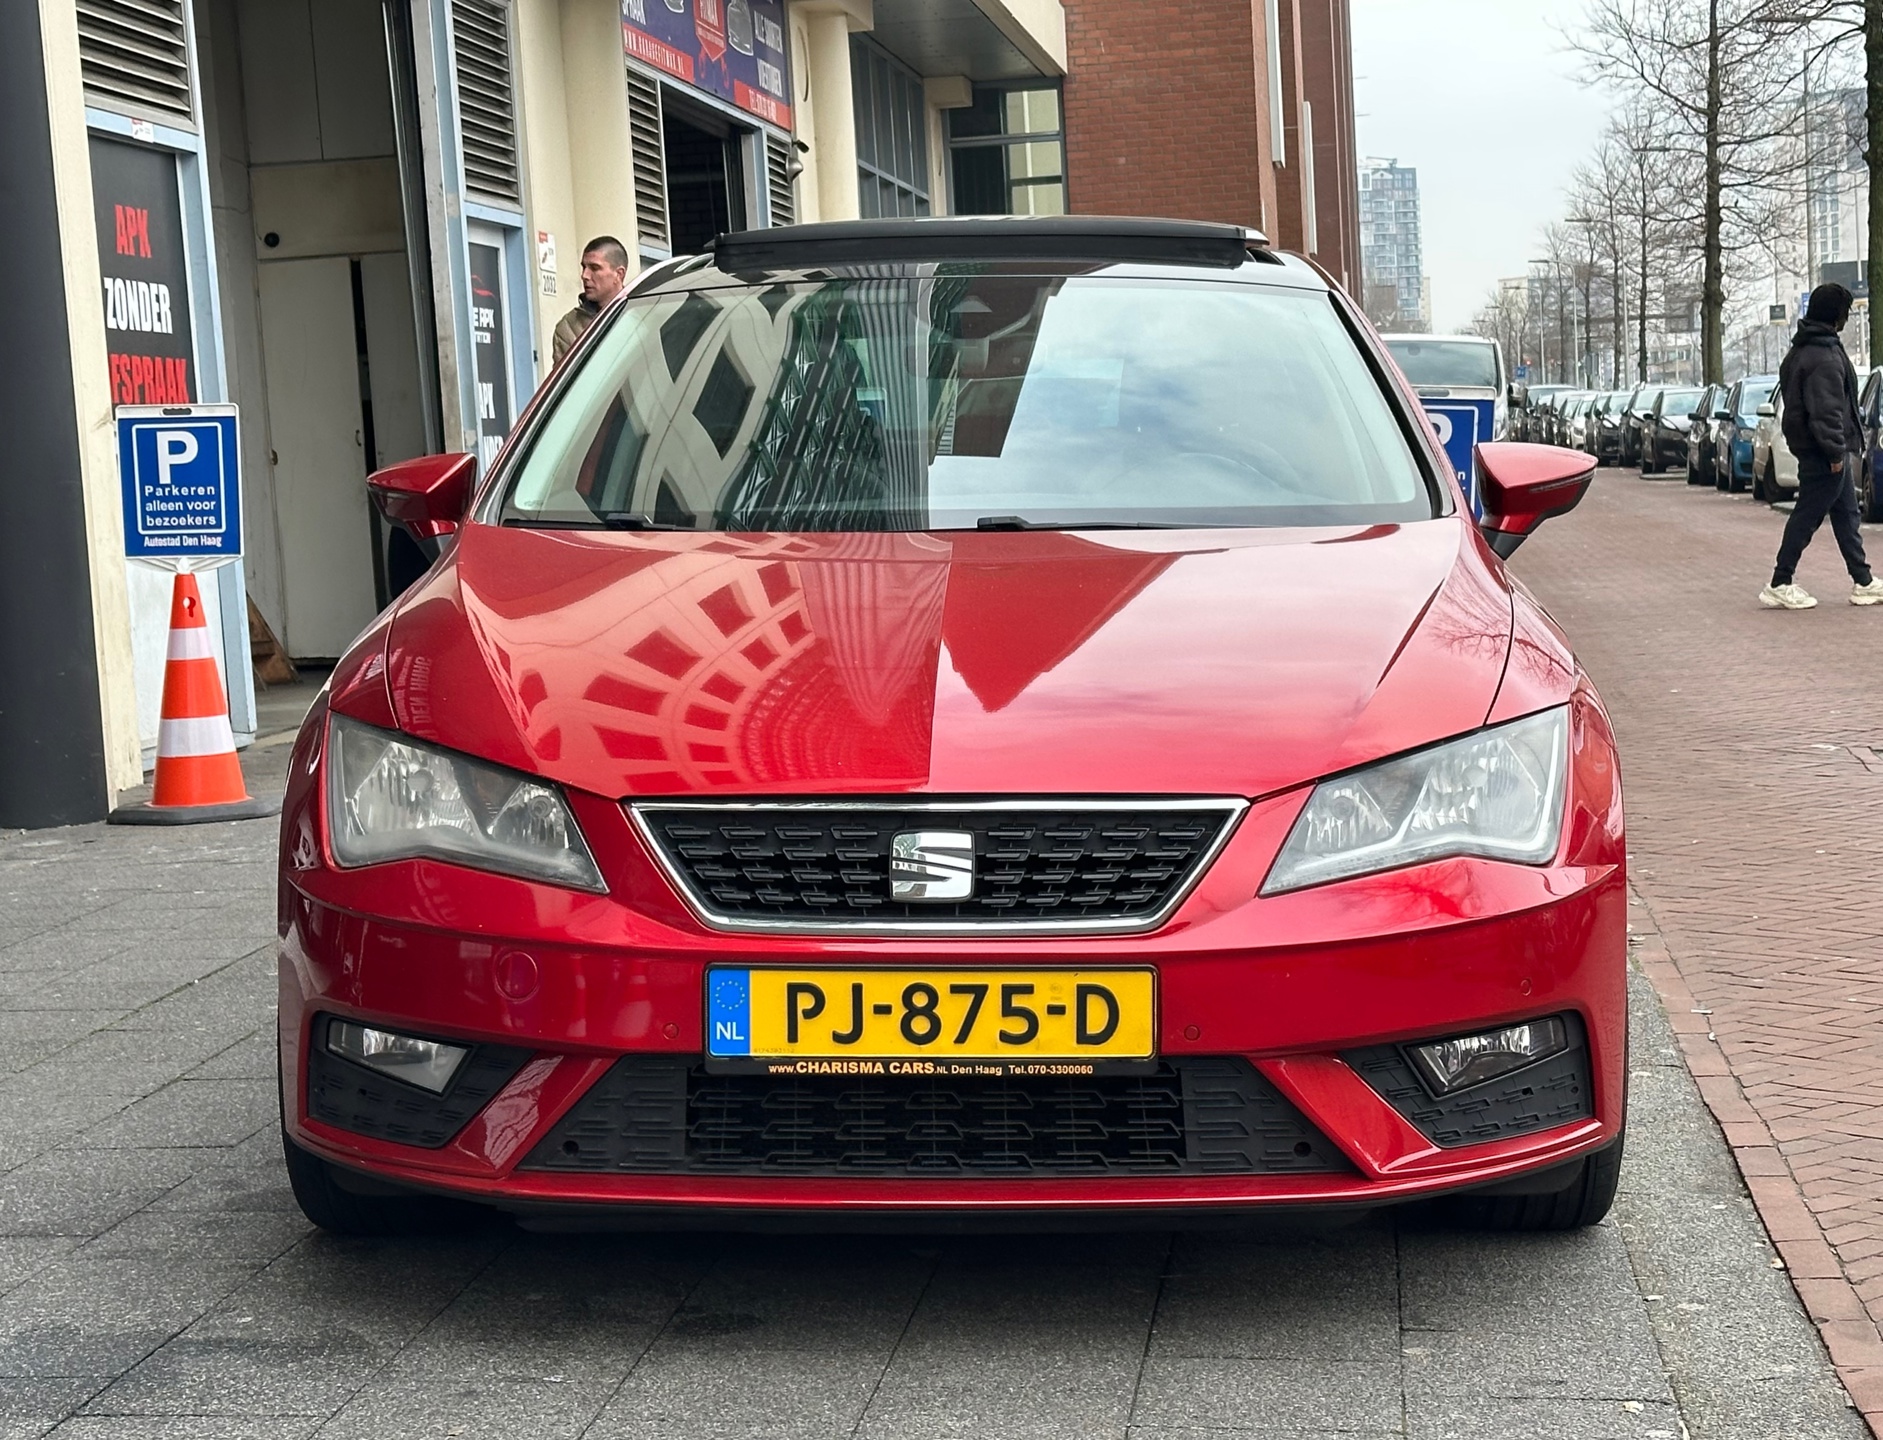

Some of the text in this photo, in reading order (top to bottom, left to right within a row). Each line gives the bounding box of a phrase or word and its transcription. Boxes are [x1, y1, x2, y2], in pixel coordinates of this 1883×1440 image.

[114, 204, 152, 258] APK
[103, 277, 173, 334] ZONDER
[156, 430, 199, 485] P
[144, 485, 216, 497] Parkeren
[145, 500, 216, 512] alleen voor
[146, 514, 217, 527] bezoekers
[144, 535, 222, 547] Autostad Den Haag
[786, 982, 1120, 1046] PJ-875-D
[715, 1021, 745, 1040] NL
[951, 1065, 973, 1074] Den
[975, 1065, 1002, 1076] Haag
